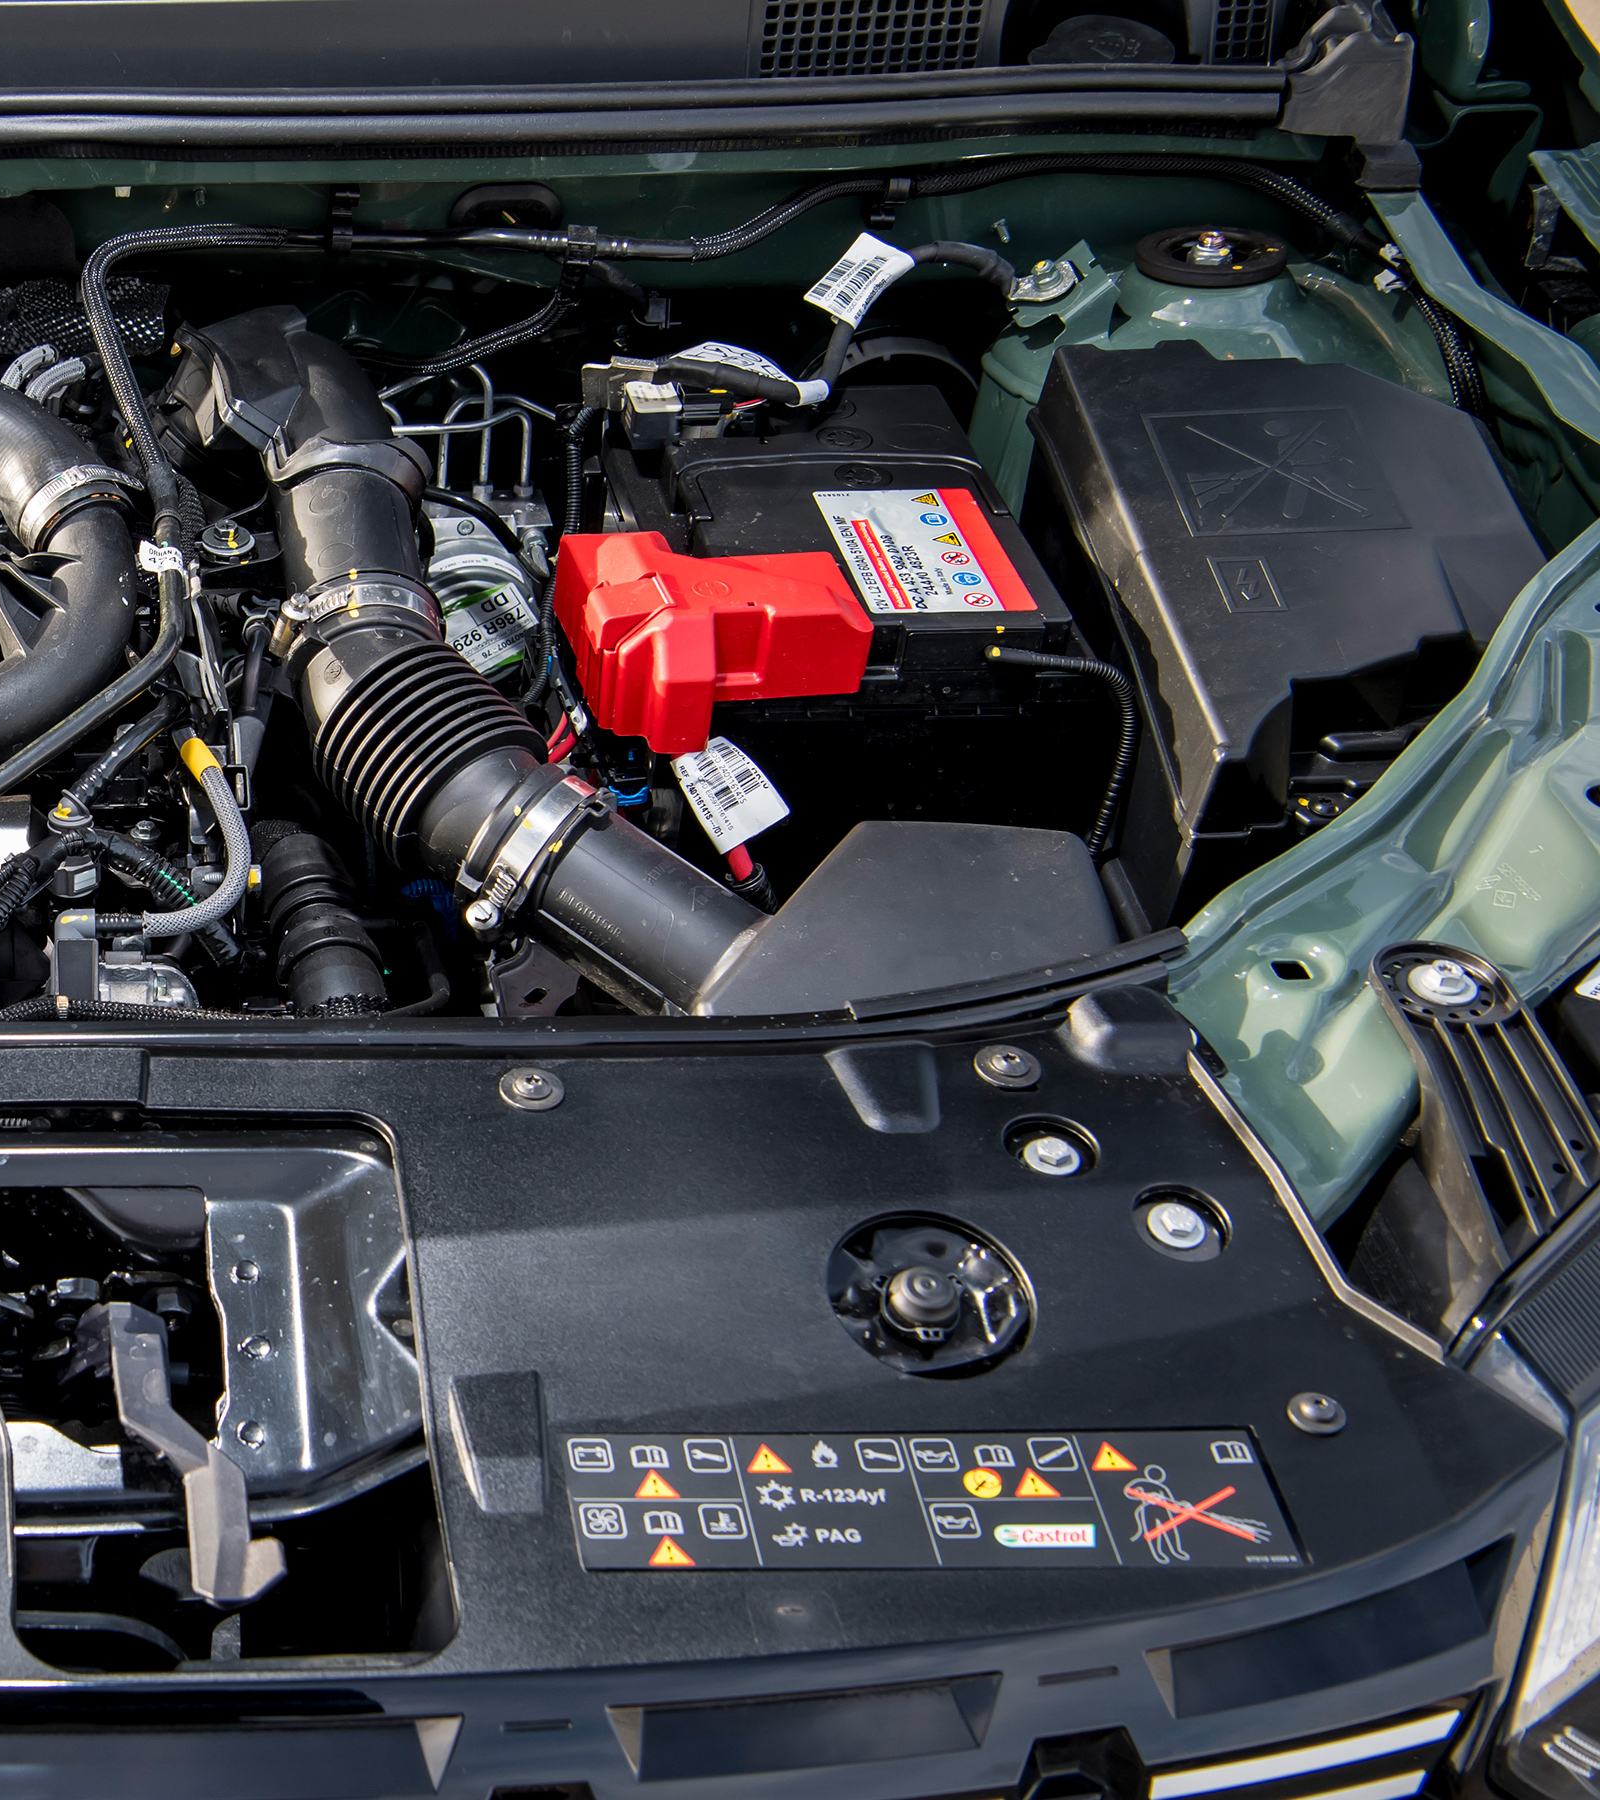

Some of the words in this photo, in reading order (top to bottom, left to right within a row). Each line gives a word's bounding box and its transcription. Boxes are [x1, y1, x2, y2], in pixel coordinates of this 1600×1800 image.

[831, 514, 848, 525] MF
[149, 548, 173, 557] ORHAN
[844, 539, 863, 554] 510A
[851, 554, 871, 570] 60Ah
[860, 571, 877, 585] EFB
[897, 572, 917, 585] 453
[939, 582, 954, 595] Made
[480, 591, 510, 613] DD
[873, 598, 891, 610] 12V
[482, 607, 526, 635] 786R
[452, 629, 482, 652] 929
[678, 765, 690, 778] REF
[799, 1487, 887, 1506] R-1234yf
[814, 1528, 862, 1544] PAG
[1021, 1528, 1088, 1544] Castrol
